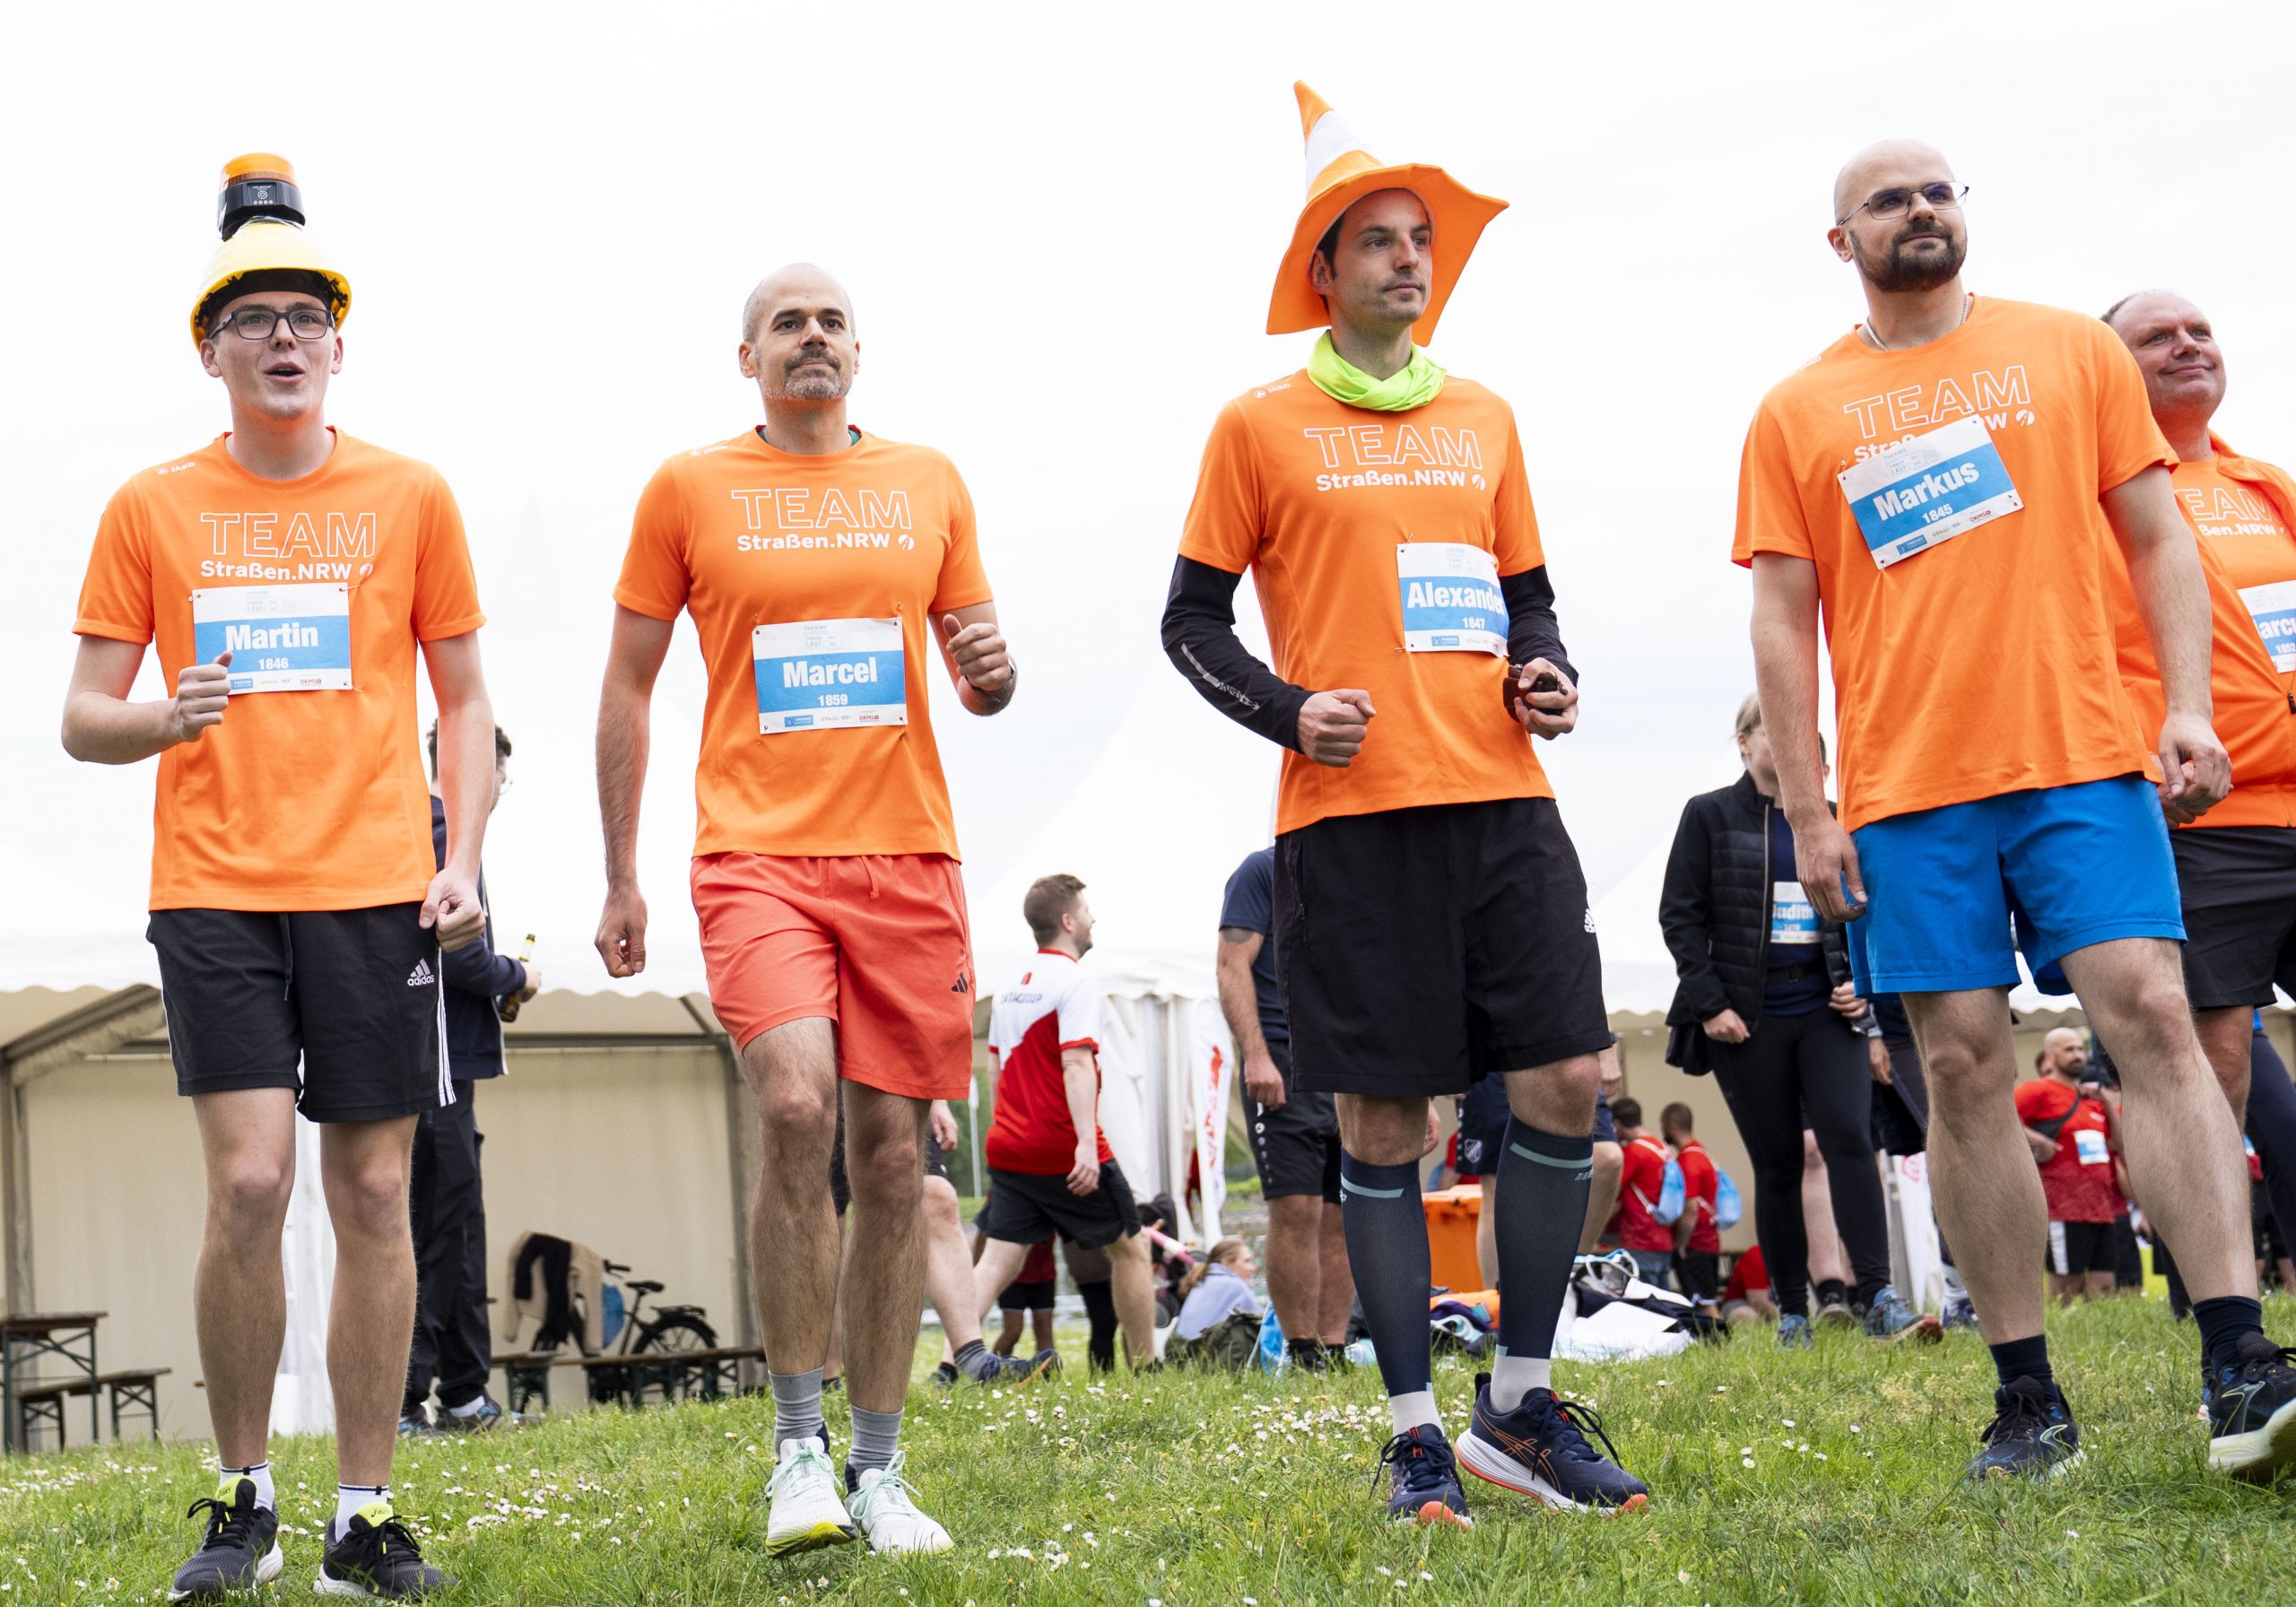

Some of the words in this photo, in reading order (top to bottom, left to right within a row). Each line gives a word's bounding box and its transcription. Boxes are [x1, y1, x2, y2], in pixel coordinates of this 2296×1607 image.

[1843, 365, 2031, 439] TEAM
[1303, 424, 1483, 471] TEAM
[1316, 469, 1465, 491] Straßen.NRW
[1872, 462, 1979, 521] Markus
[731, 488, 913, 530] TEAM
[1922, 503, 1953, 525] 1845
[2173, 487, 2283, 522] EAM
[200, 512, 377, 558] TEAM
[736, 533, 891, 552] Straßen.NRW
[2198, 523, 2277, 537] ßen.NRW
[200, 560, 352, 581] Straßen.NRW
[1406, 581, 1506, 616] Alexander
[225, 621, 319, 651] Martin
[1462, 616, 1486, 630] 1847
[258, 657, 289, 671] 1846
[782, 656, 878, 689] Marcel
[818, 693, 848, 707] 1859
[407, 975, 435, 986] adidas
